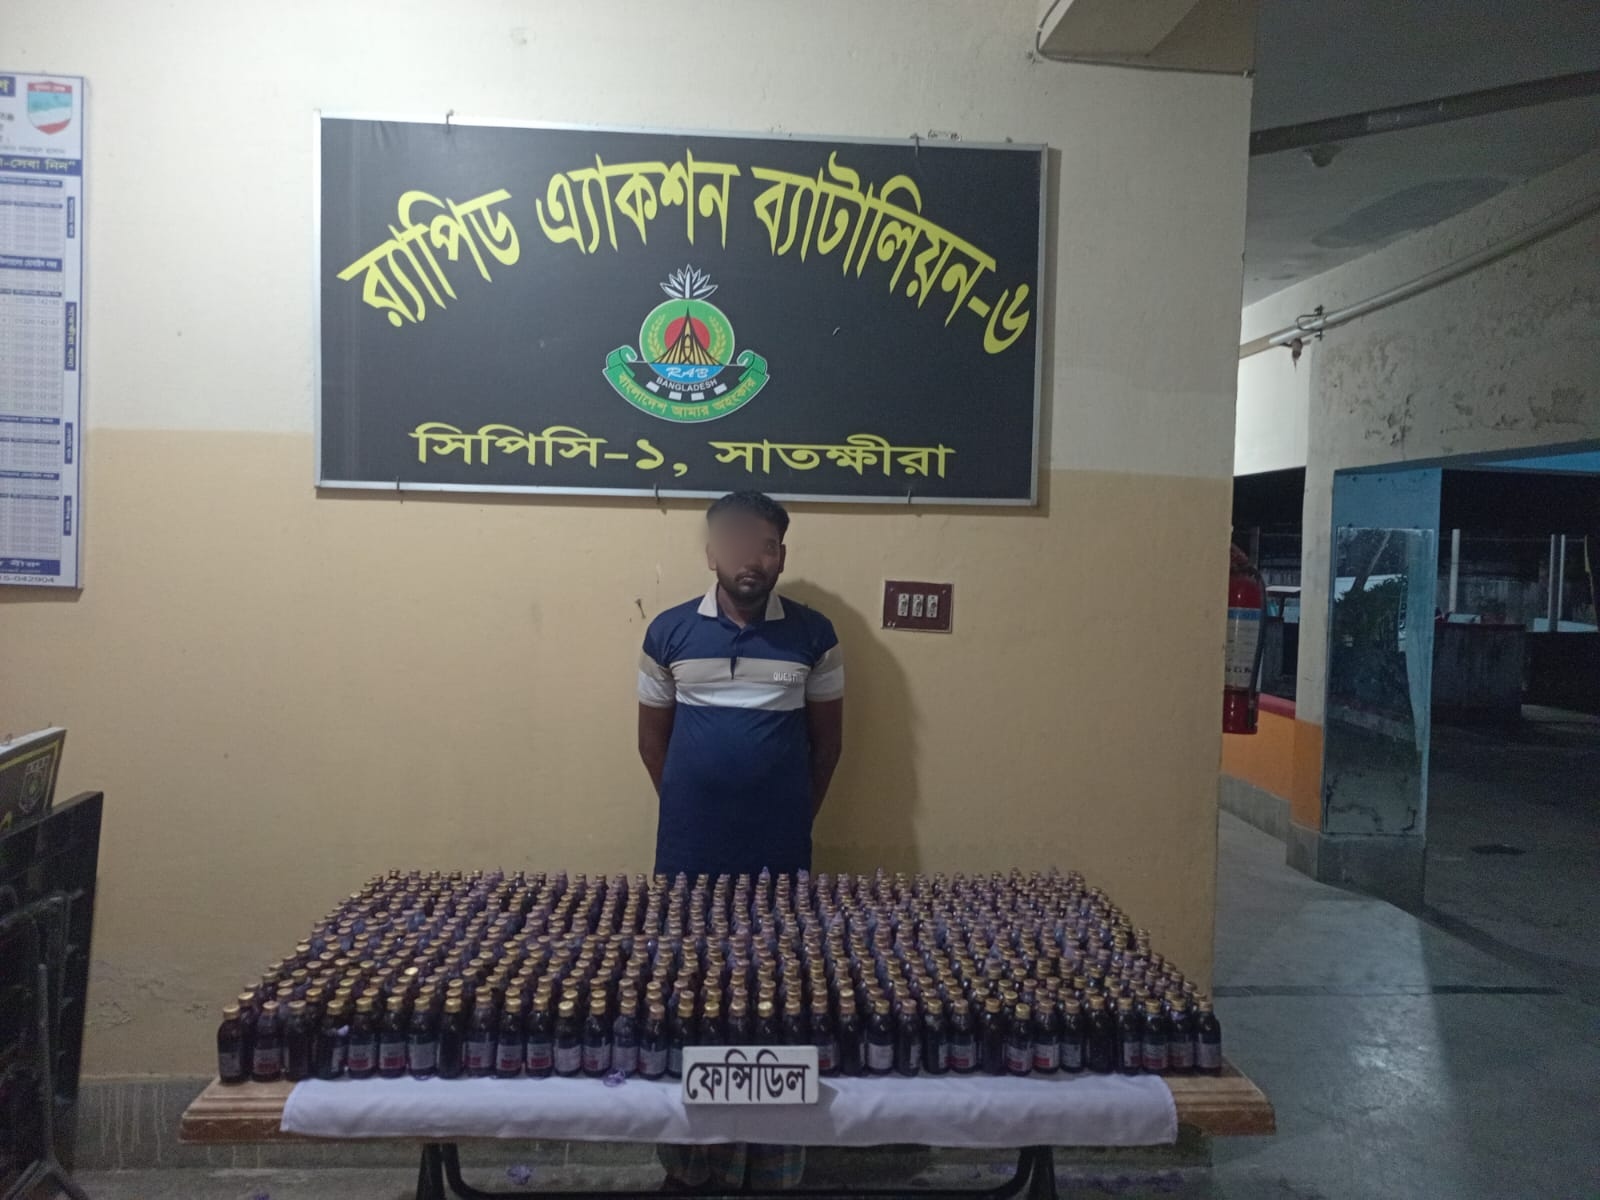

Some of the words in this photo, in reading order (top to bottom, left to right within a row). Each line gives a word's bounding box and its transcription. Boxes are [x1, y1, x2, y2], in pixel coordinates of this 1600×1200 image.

[536, 147, 741, 254] এ্যাকশন
[665, 366, 708, 379] RAB
[655, 376, 718, 392] BANGLADESH
[671, 404, 710, 417] আমার
[708, 432, 956, 479] সাতক্ষীরা
